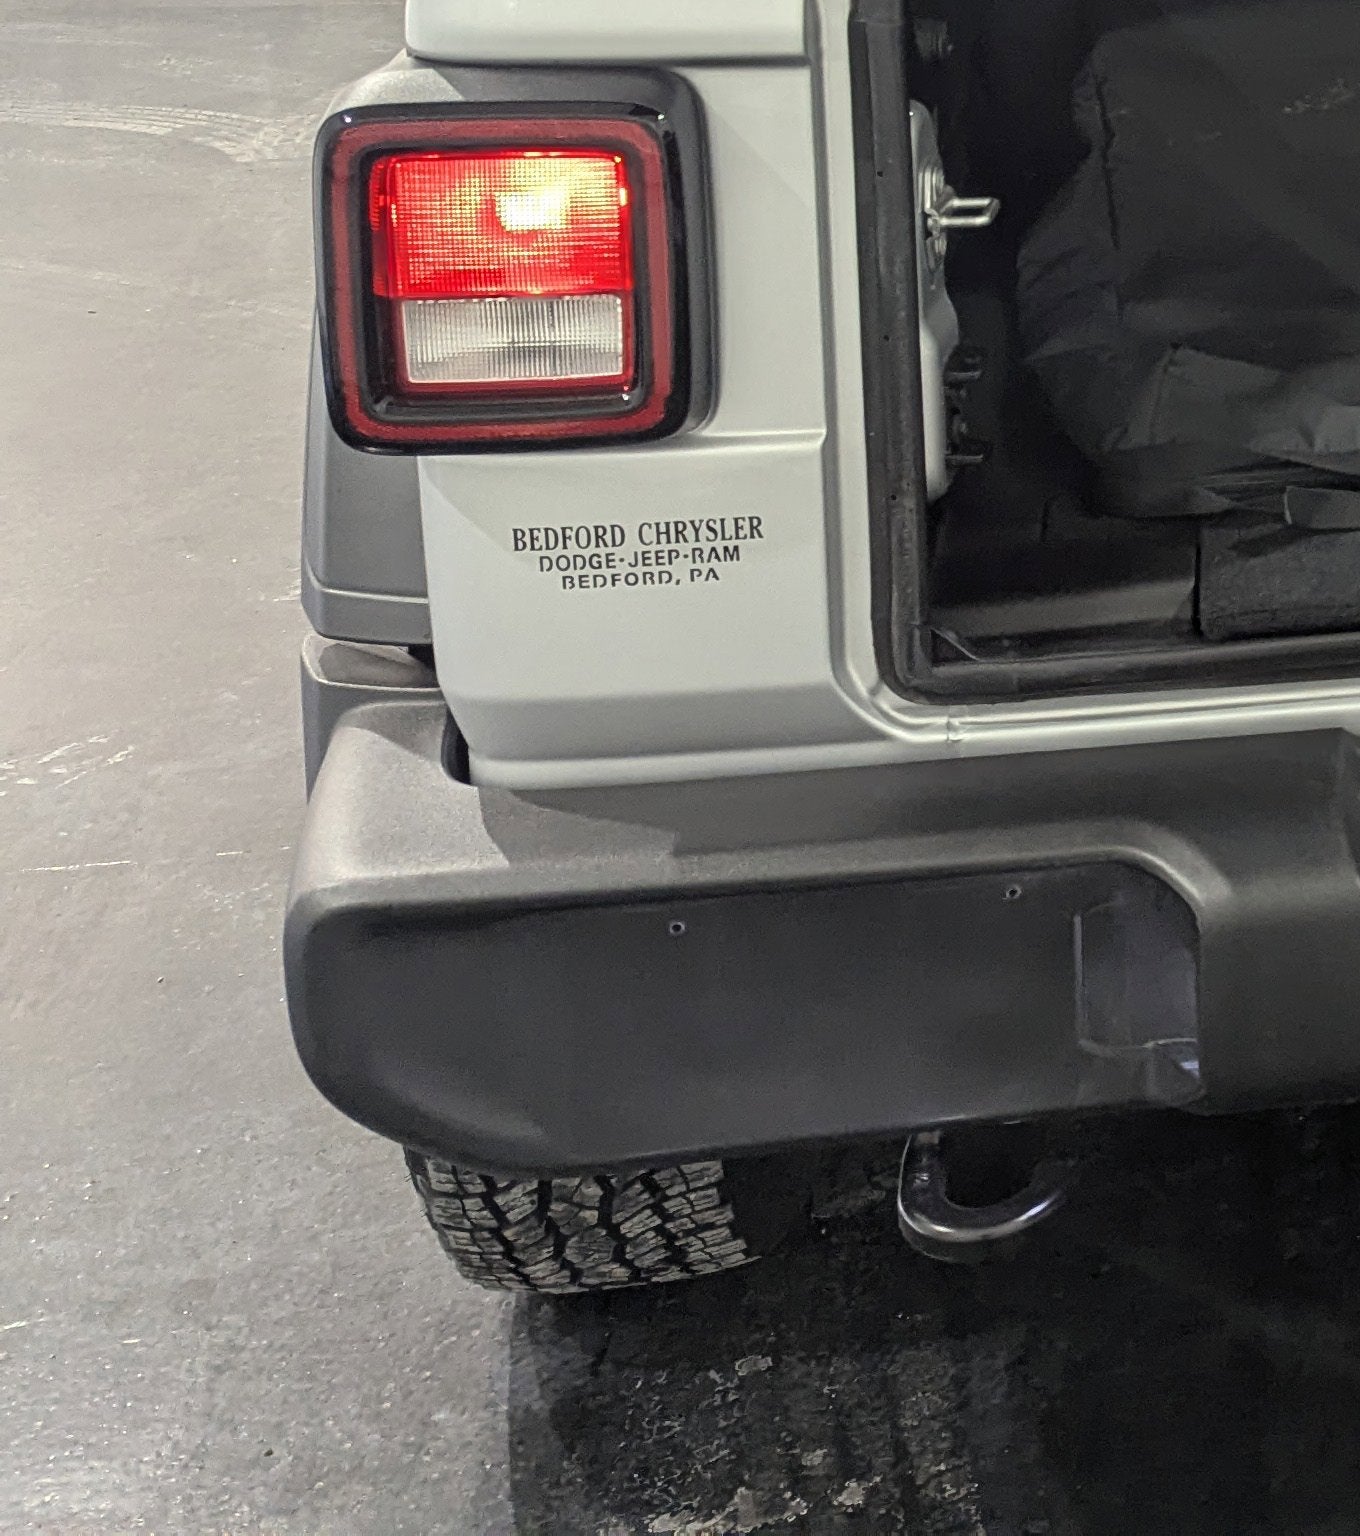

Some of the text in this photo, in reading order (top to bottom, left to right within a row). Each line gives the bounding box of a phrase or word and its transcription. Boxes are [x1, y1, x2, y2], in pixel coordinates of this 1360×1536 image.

[512, 515, 764, 552] BEDFORD CHRYSLER
[562, 567, 720, 590] BEDFORD, PA
